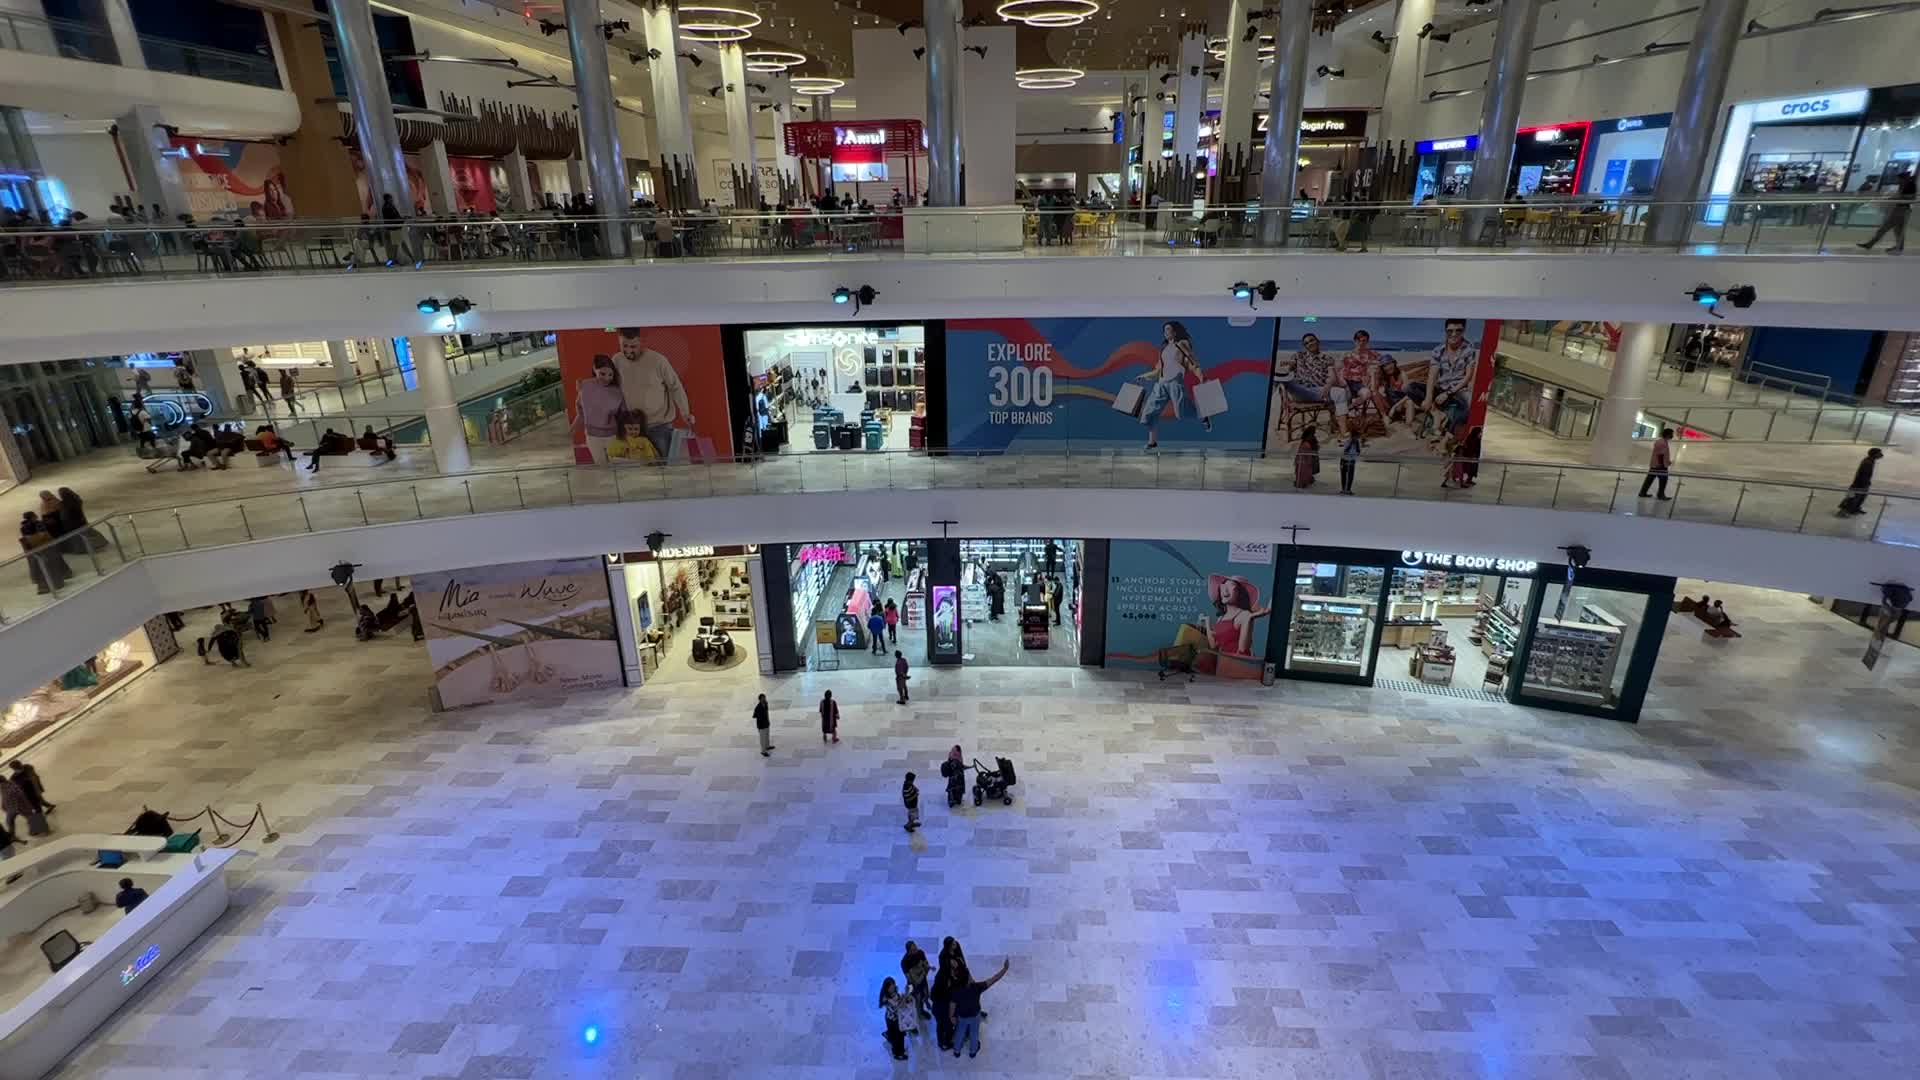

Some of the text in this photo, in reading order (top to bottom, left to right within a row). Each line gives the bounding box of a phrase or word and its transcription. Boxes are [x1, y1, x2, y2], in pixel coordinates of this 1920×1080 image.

[1781, 99, 1830, 115] crocs
[1300, 120, 1345, 131] Sugar Free
[843, 128, 885, 145] Amul
[987, 343, 1052, 361] EXPLORE
[988, 365, 1053, 407] 300
[989, 411, 1053, 424] TOP BRANDS
[1424, 552, 1537, 572] THE BODY SHOP
[1123, 577, 1165, 585] ANCHOR
[439, 578, 480, 612] Mia
[1116, 585, 1201, 594] INCLUDING LULU
[1121, 595, 1194, 604] HYPERMARKET
